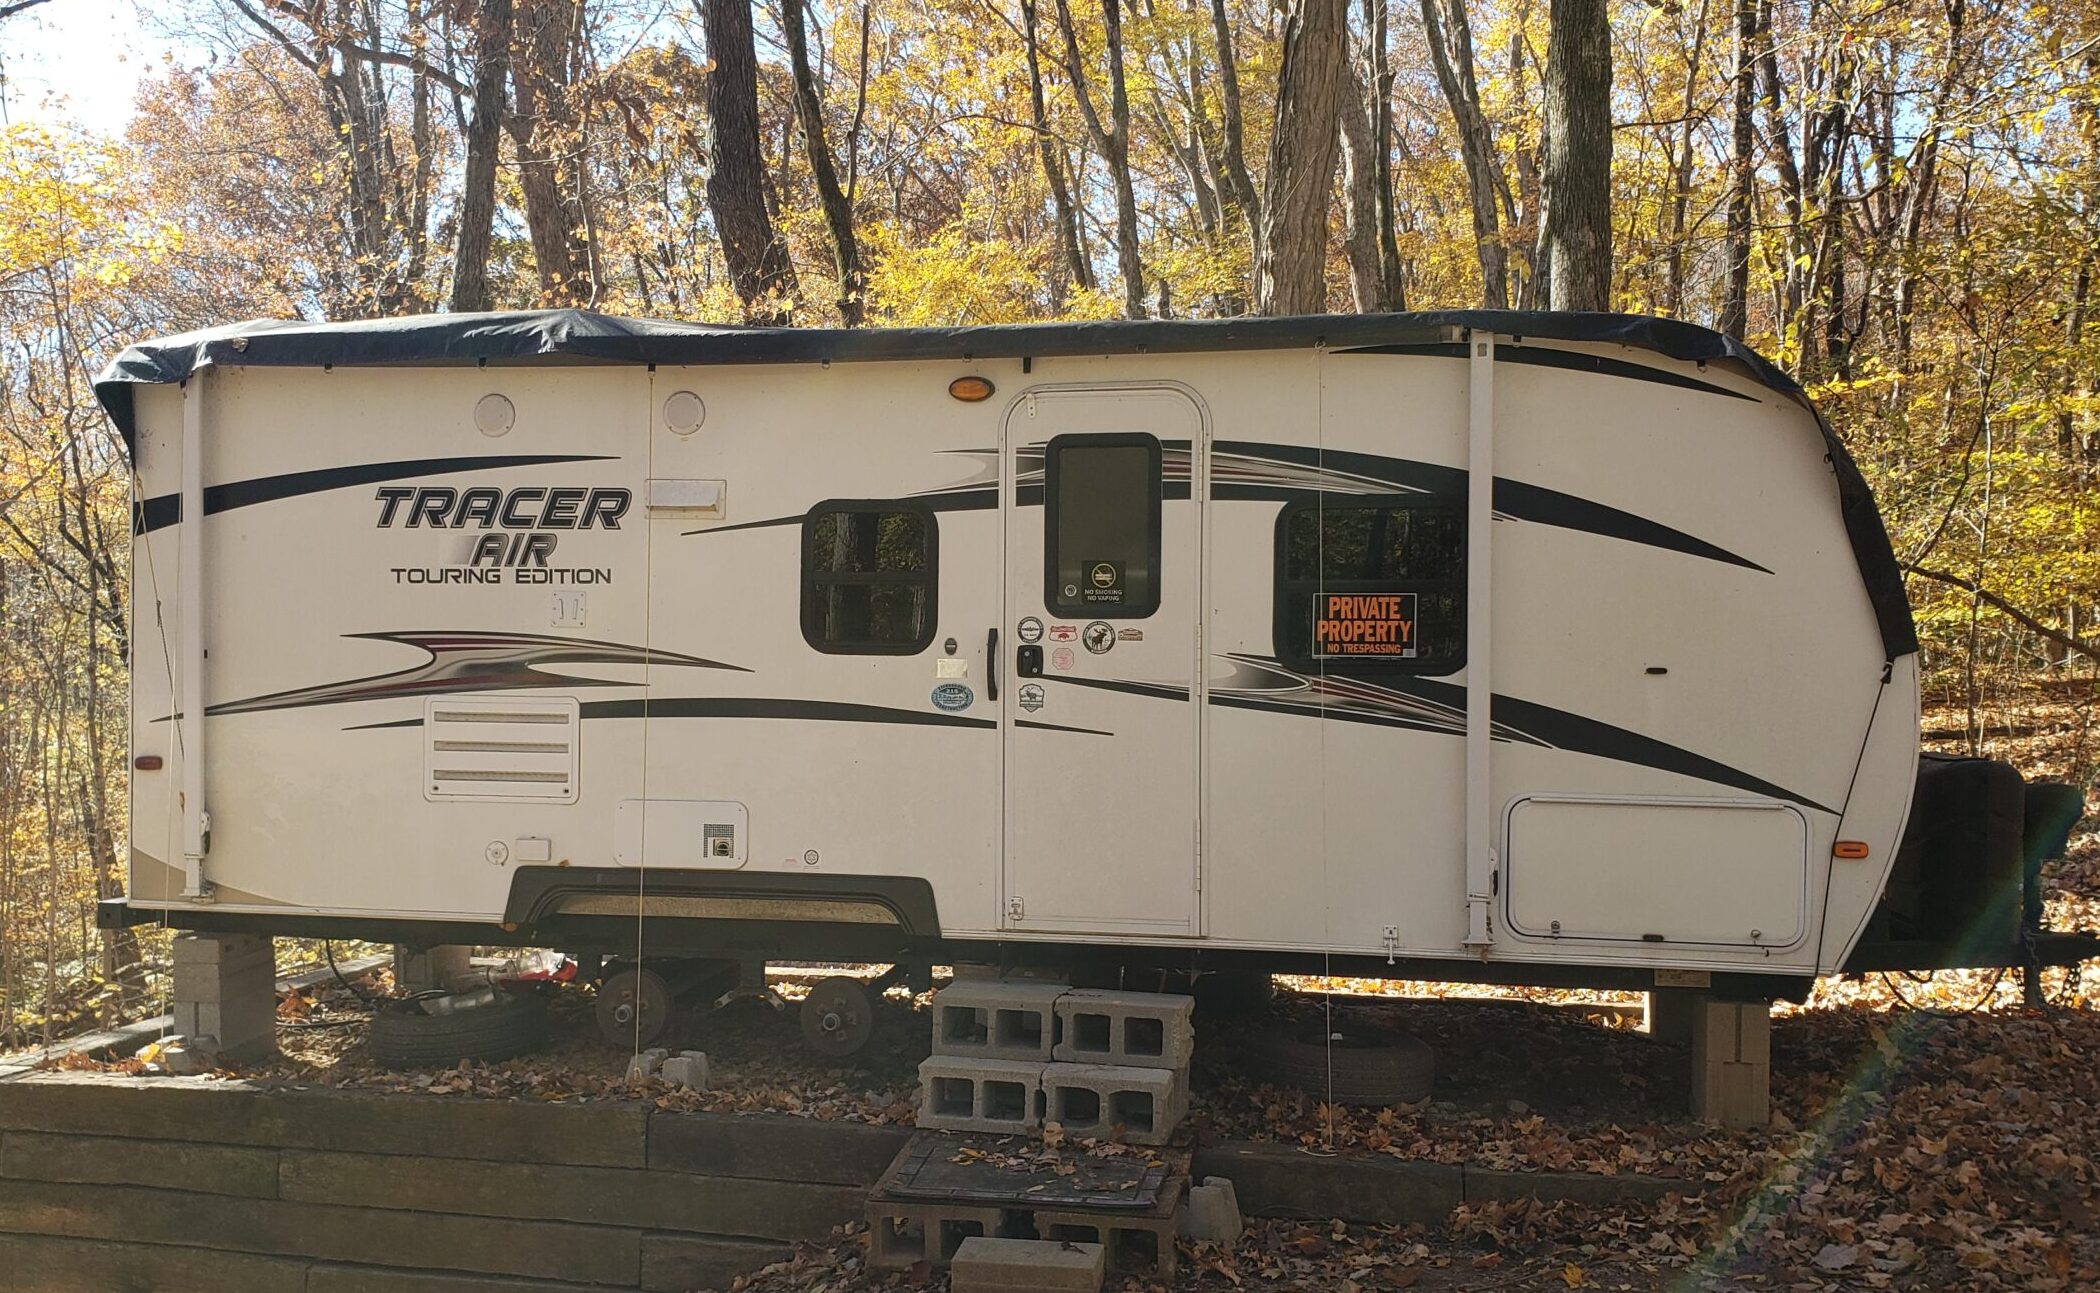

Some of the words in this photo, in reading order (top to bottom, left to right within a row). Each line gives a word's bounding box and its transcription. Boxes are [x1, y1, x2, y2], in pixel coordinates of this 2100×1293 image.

[375, 487, 632, 530] TRACER
[470, 532, 558, 567] AIR
[390, 568, 501, 585] TOURING
[515, 568, 612, 585] EDITION
[1328, 596, 1401, 620] PRIVATE
[1316, 620, 1412, 642] PROPERTY
[1327, 643, 1340, 653] NO
[1343, 643, 1401, 654] TRESPASSING
